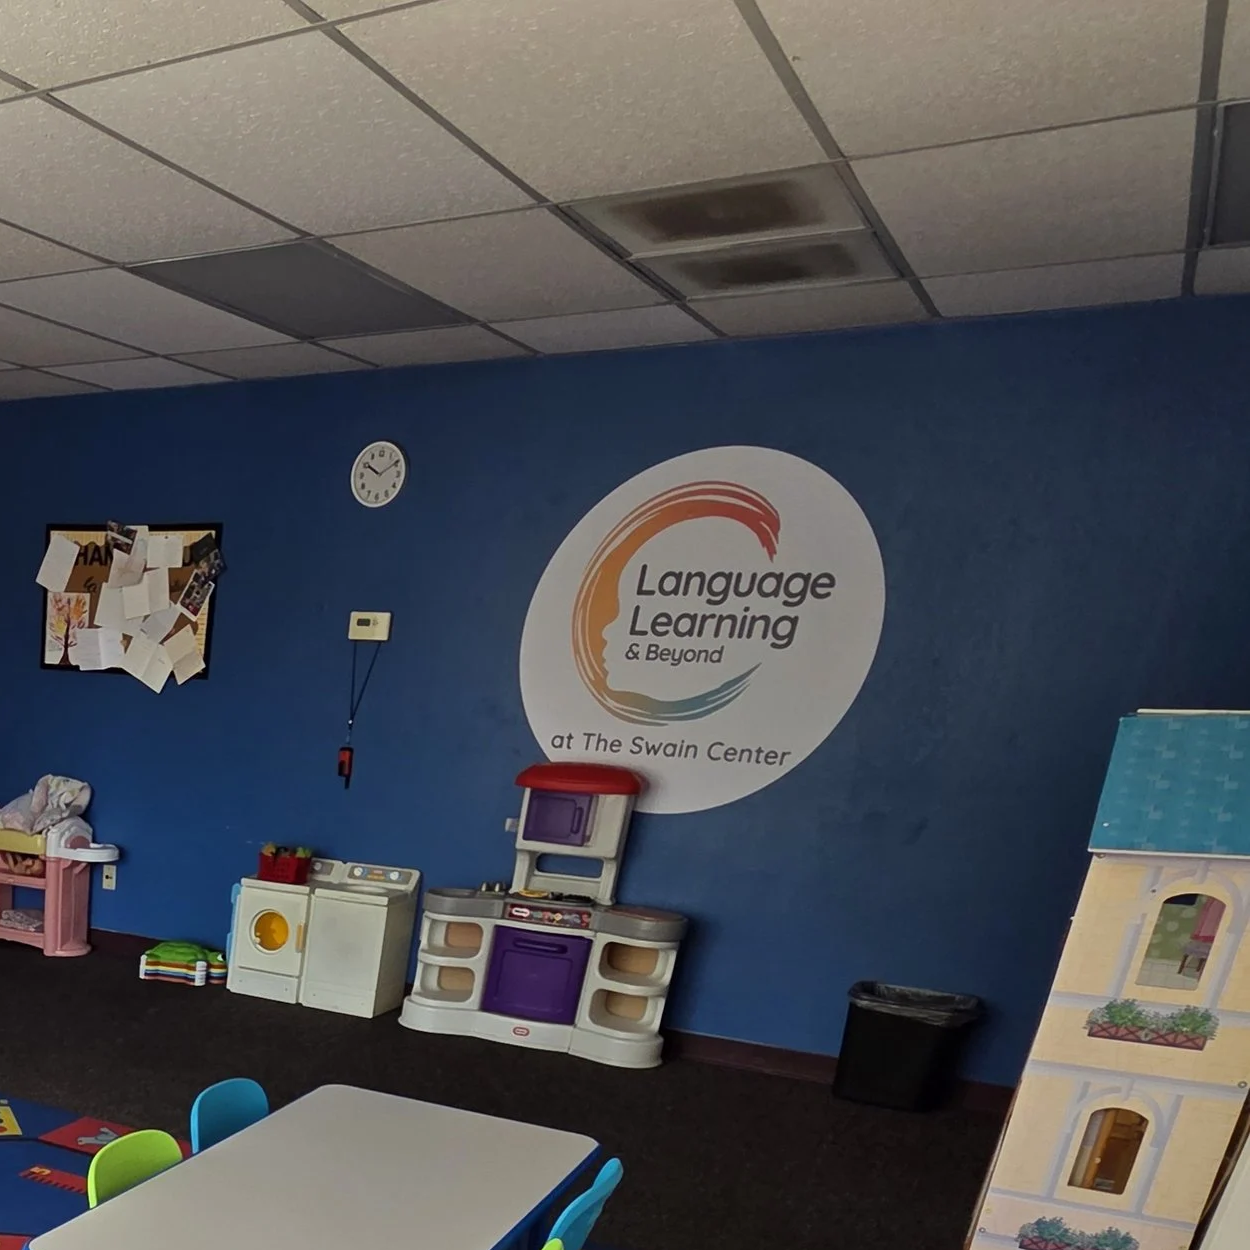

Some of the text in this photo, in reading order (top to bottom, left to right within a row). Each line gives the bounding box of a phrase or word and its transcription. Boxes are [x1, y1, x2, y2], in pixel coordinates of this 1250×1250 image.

[75, 544, 114, 566] HAN
[636, 564, 837, 607] Language
[629, 605, 799, 649] Learning
[625, 644, 724, 666] & Beyond
[551, 733, 792, 767] at The Swain Center
